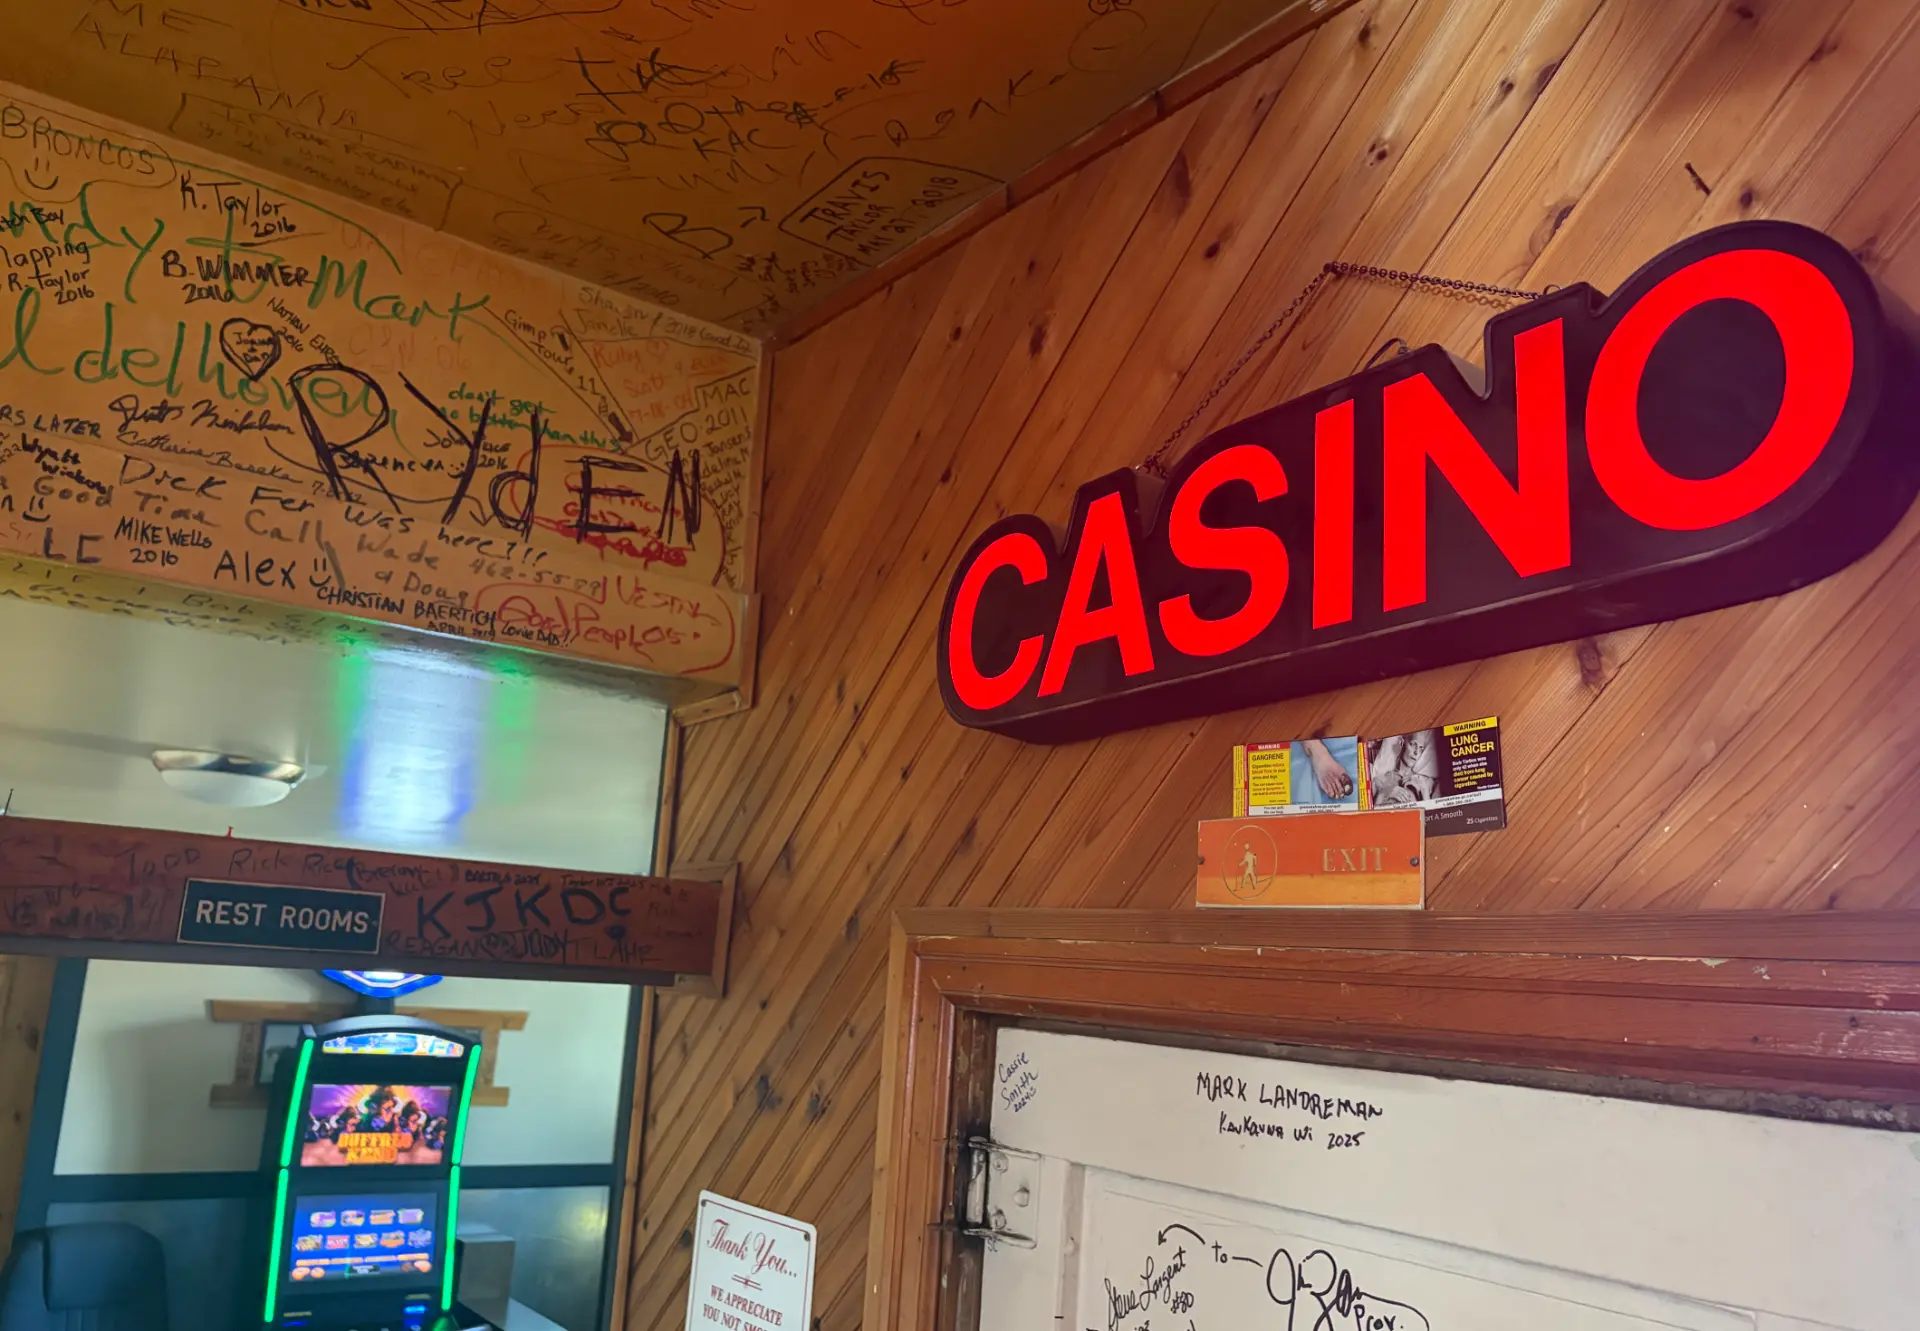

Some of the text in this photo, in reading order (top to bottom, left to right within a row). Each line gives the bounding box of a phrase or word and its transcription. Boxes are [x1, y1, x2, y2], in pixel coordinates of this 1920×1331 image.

[1, 105, 156, 176] BRONCOS
[180, 170, 287, 226] K. Taylor
[799, 170, 890, 225] TRAVIS
[250, 220, 297, 238] 2016
[825, 202, 897, 243] TAYLOR
[28, 268, 90, 292] Taylor
[196, 254, 318, 288] WIMMER
[54, 284, 95, 305] 2016
[699, 376, 752, 409] MAC
[33, 414, 101, 438] LATER
[644, 421, 699, 462] GEO
[948, 248, 1855, 711] CASINO
[113, 515, 163, 544] MIKE
[130, 547, 180, 567] 2016
[213, 549, 297, 591] Alex
[1450, 733, 1479, 748] LUNG
[1453, 720, 1487, 732] WARNING
[1252, 752, 1284, 761] GANGRENE
[1451, 741, 1495, 758] CANCER
[1440, 809, 1464, 819] Smooth
[1322, 847, 1388, 873] EXIT
[195, 899, 268, 927] REST
[279, 905, 371, 934] ROOMS
[1196, 1071, 1247, 1102] MARK
[1327, 1131, 1366, 1150] 2025
[706, 1218, 752, 1261] Thank
[702, 1303, 721, 1322] YOU
[720, 1311, 742, 1331] NOT
[710, 1284, 783, 1327] WE APPRECIATE
